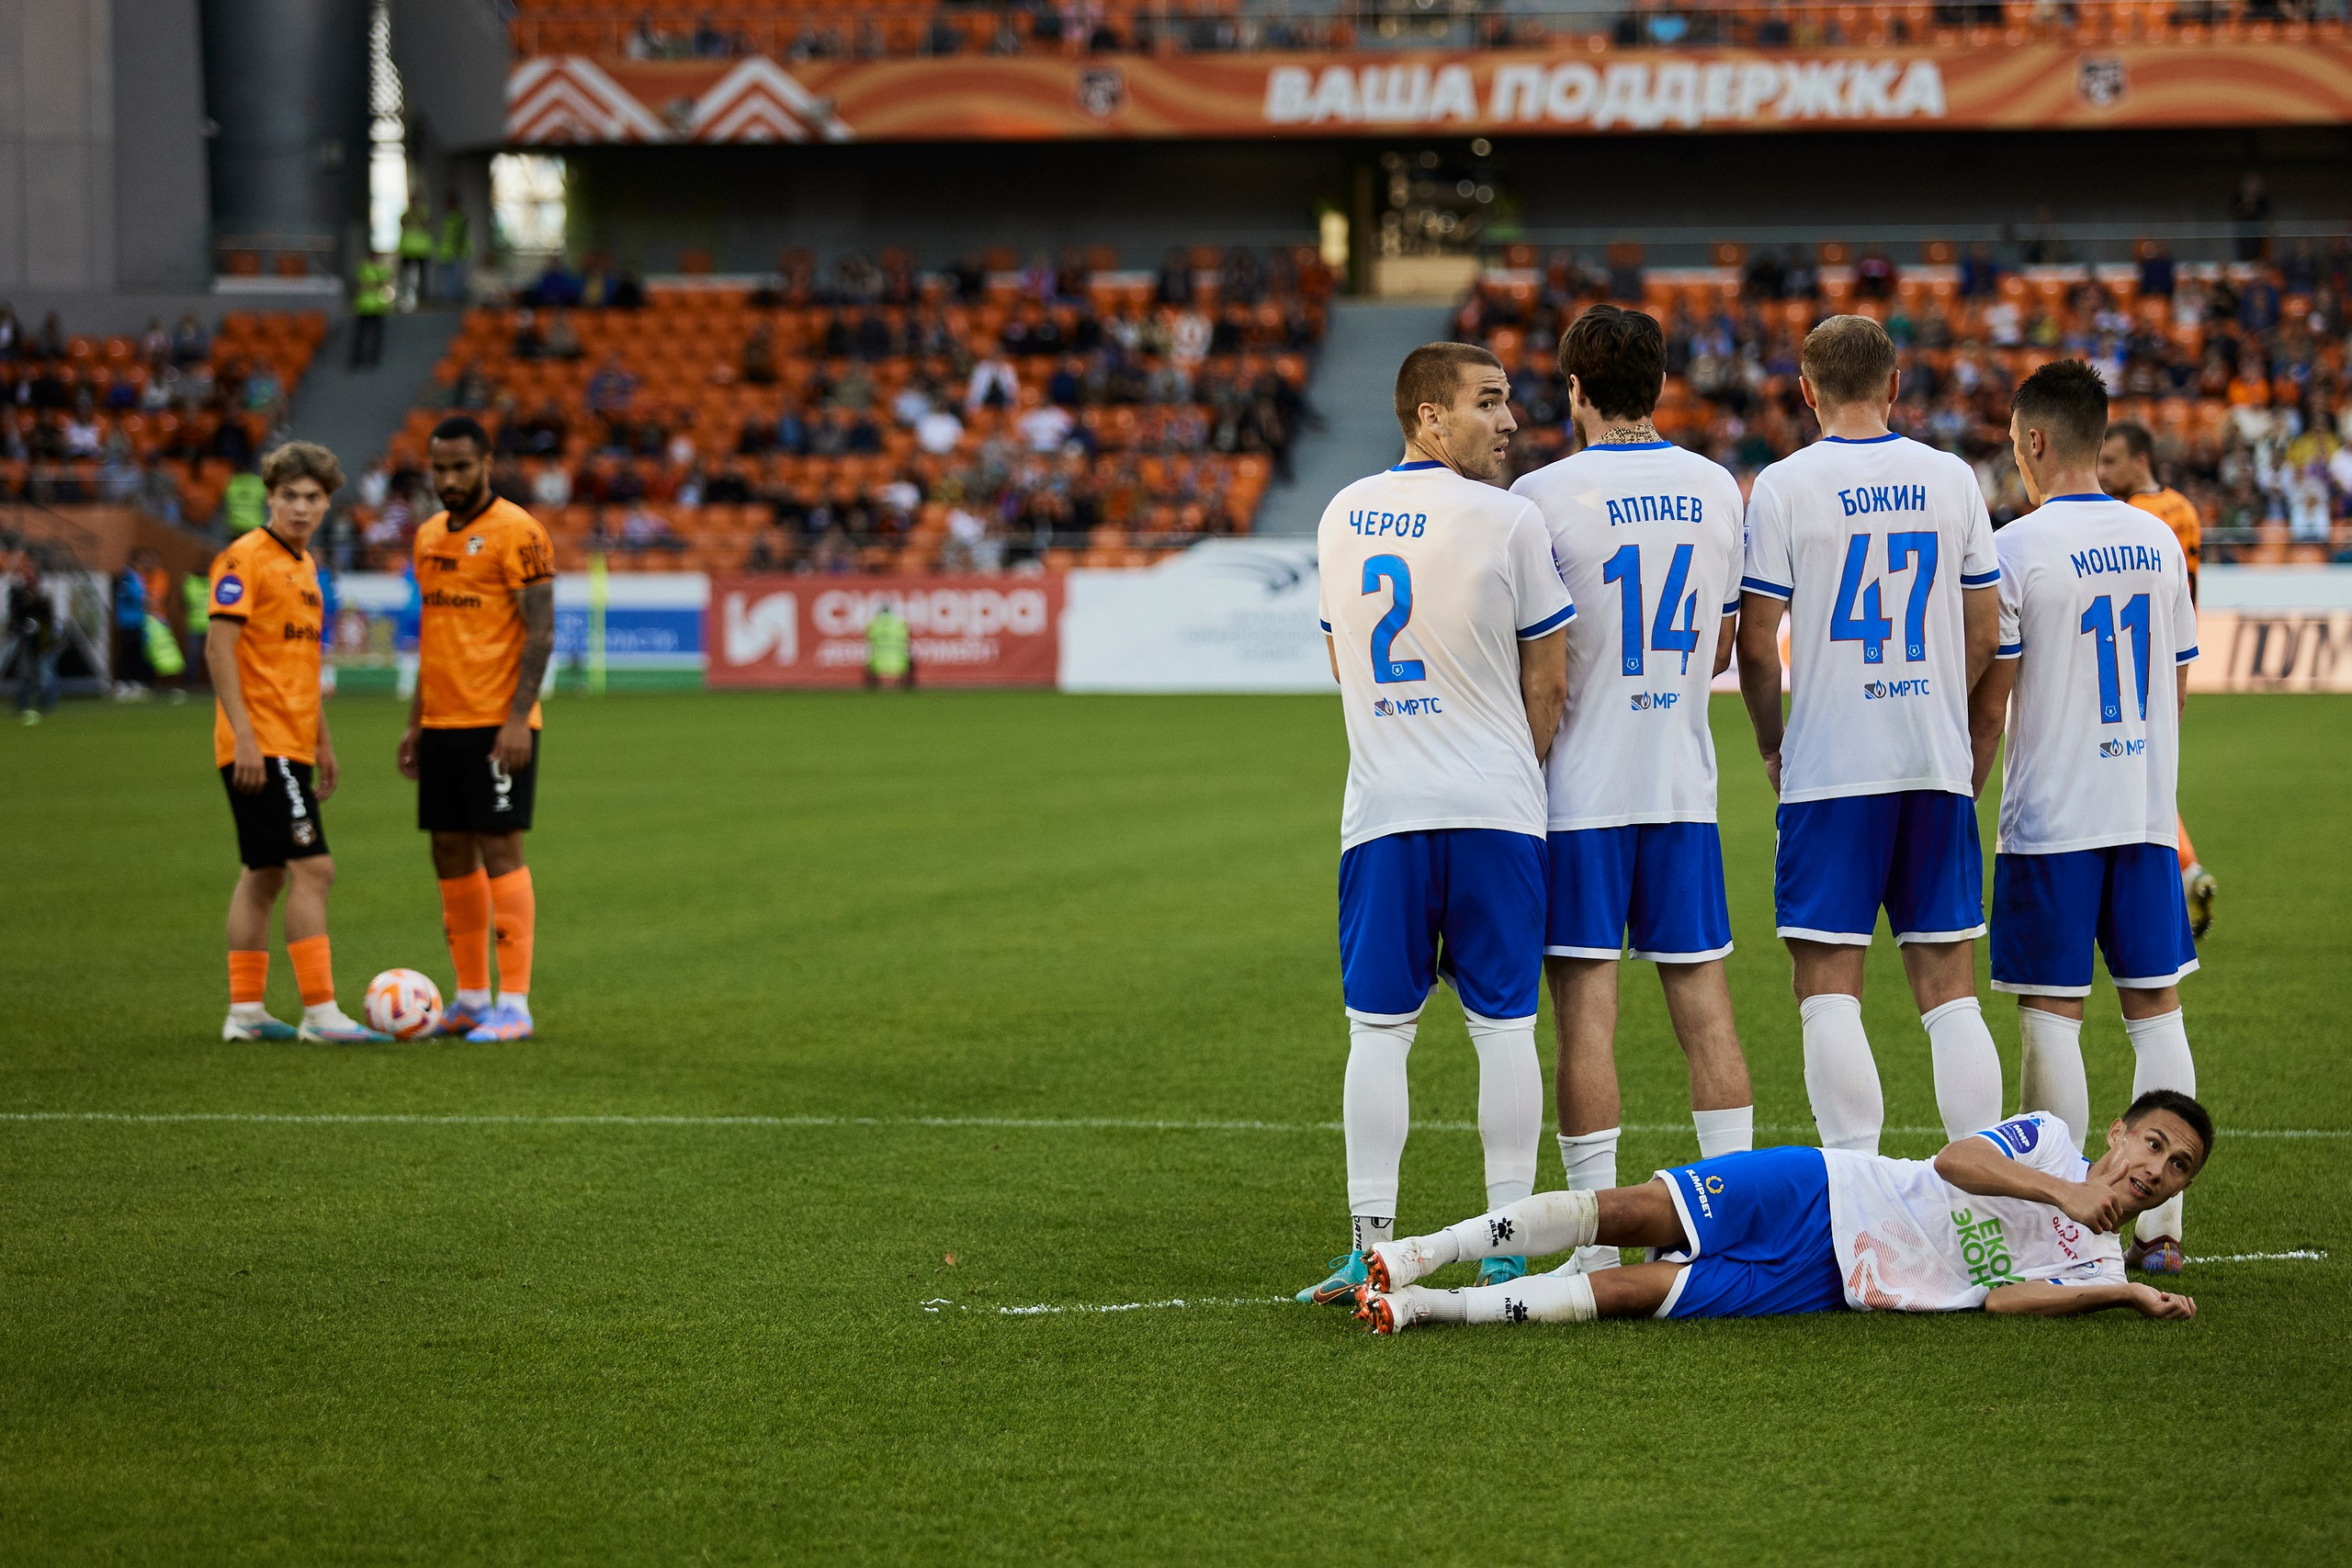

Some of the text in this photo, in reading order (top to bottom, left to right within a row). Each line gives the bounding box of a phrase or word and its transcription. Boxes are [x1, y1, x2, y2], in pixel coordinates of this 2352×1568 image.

[1264, 61, 1947, 130] ВАША ПОДДЕРЖКА
[1606, 495, 1703, 526] АППАЕВ
[1838, 484, 1926, 516] БОЖИН
[1349, 510, 1428, 538] ЧЕРОВ
[2070, 546, 2162, 579] МОЦПАН
[1602, 544, 1701, 676] 14
[1830, 531, 1939, 664] 47
[1362, 553, 1426, 683] 2
[2081, 593, 2151, 724] 11
[1653, 693, 1680, 710] МР
[1889, 679, 1929, 698] МРТС
[1396, 697, 1442, 716] МРТС
[2126, 739, 2146, 756] МР
[2012, 1123, 2030, 1147] МИР
